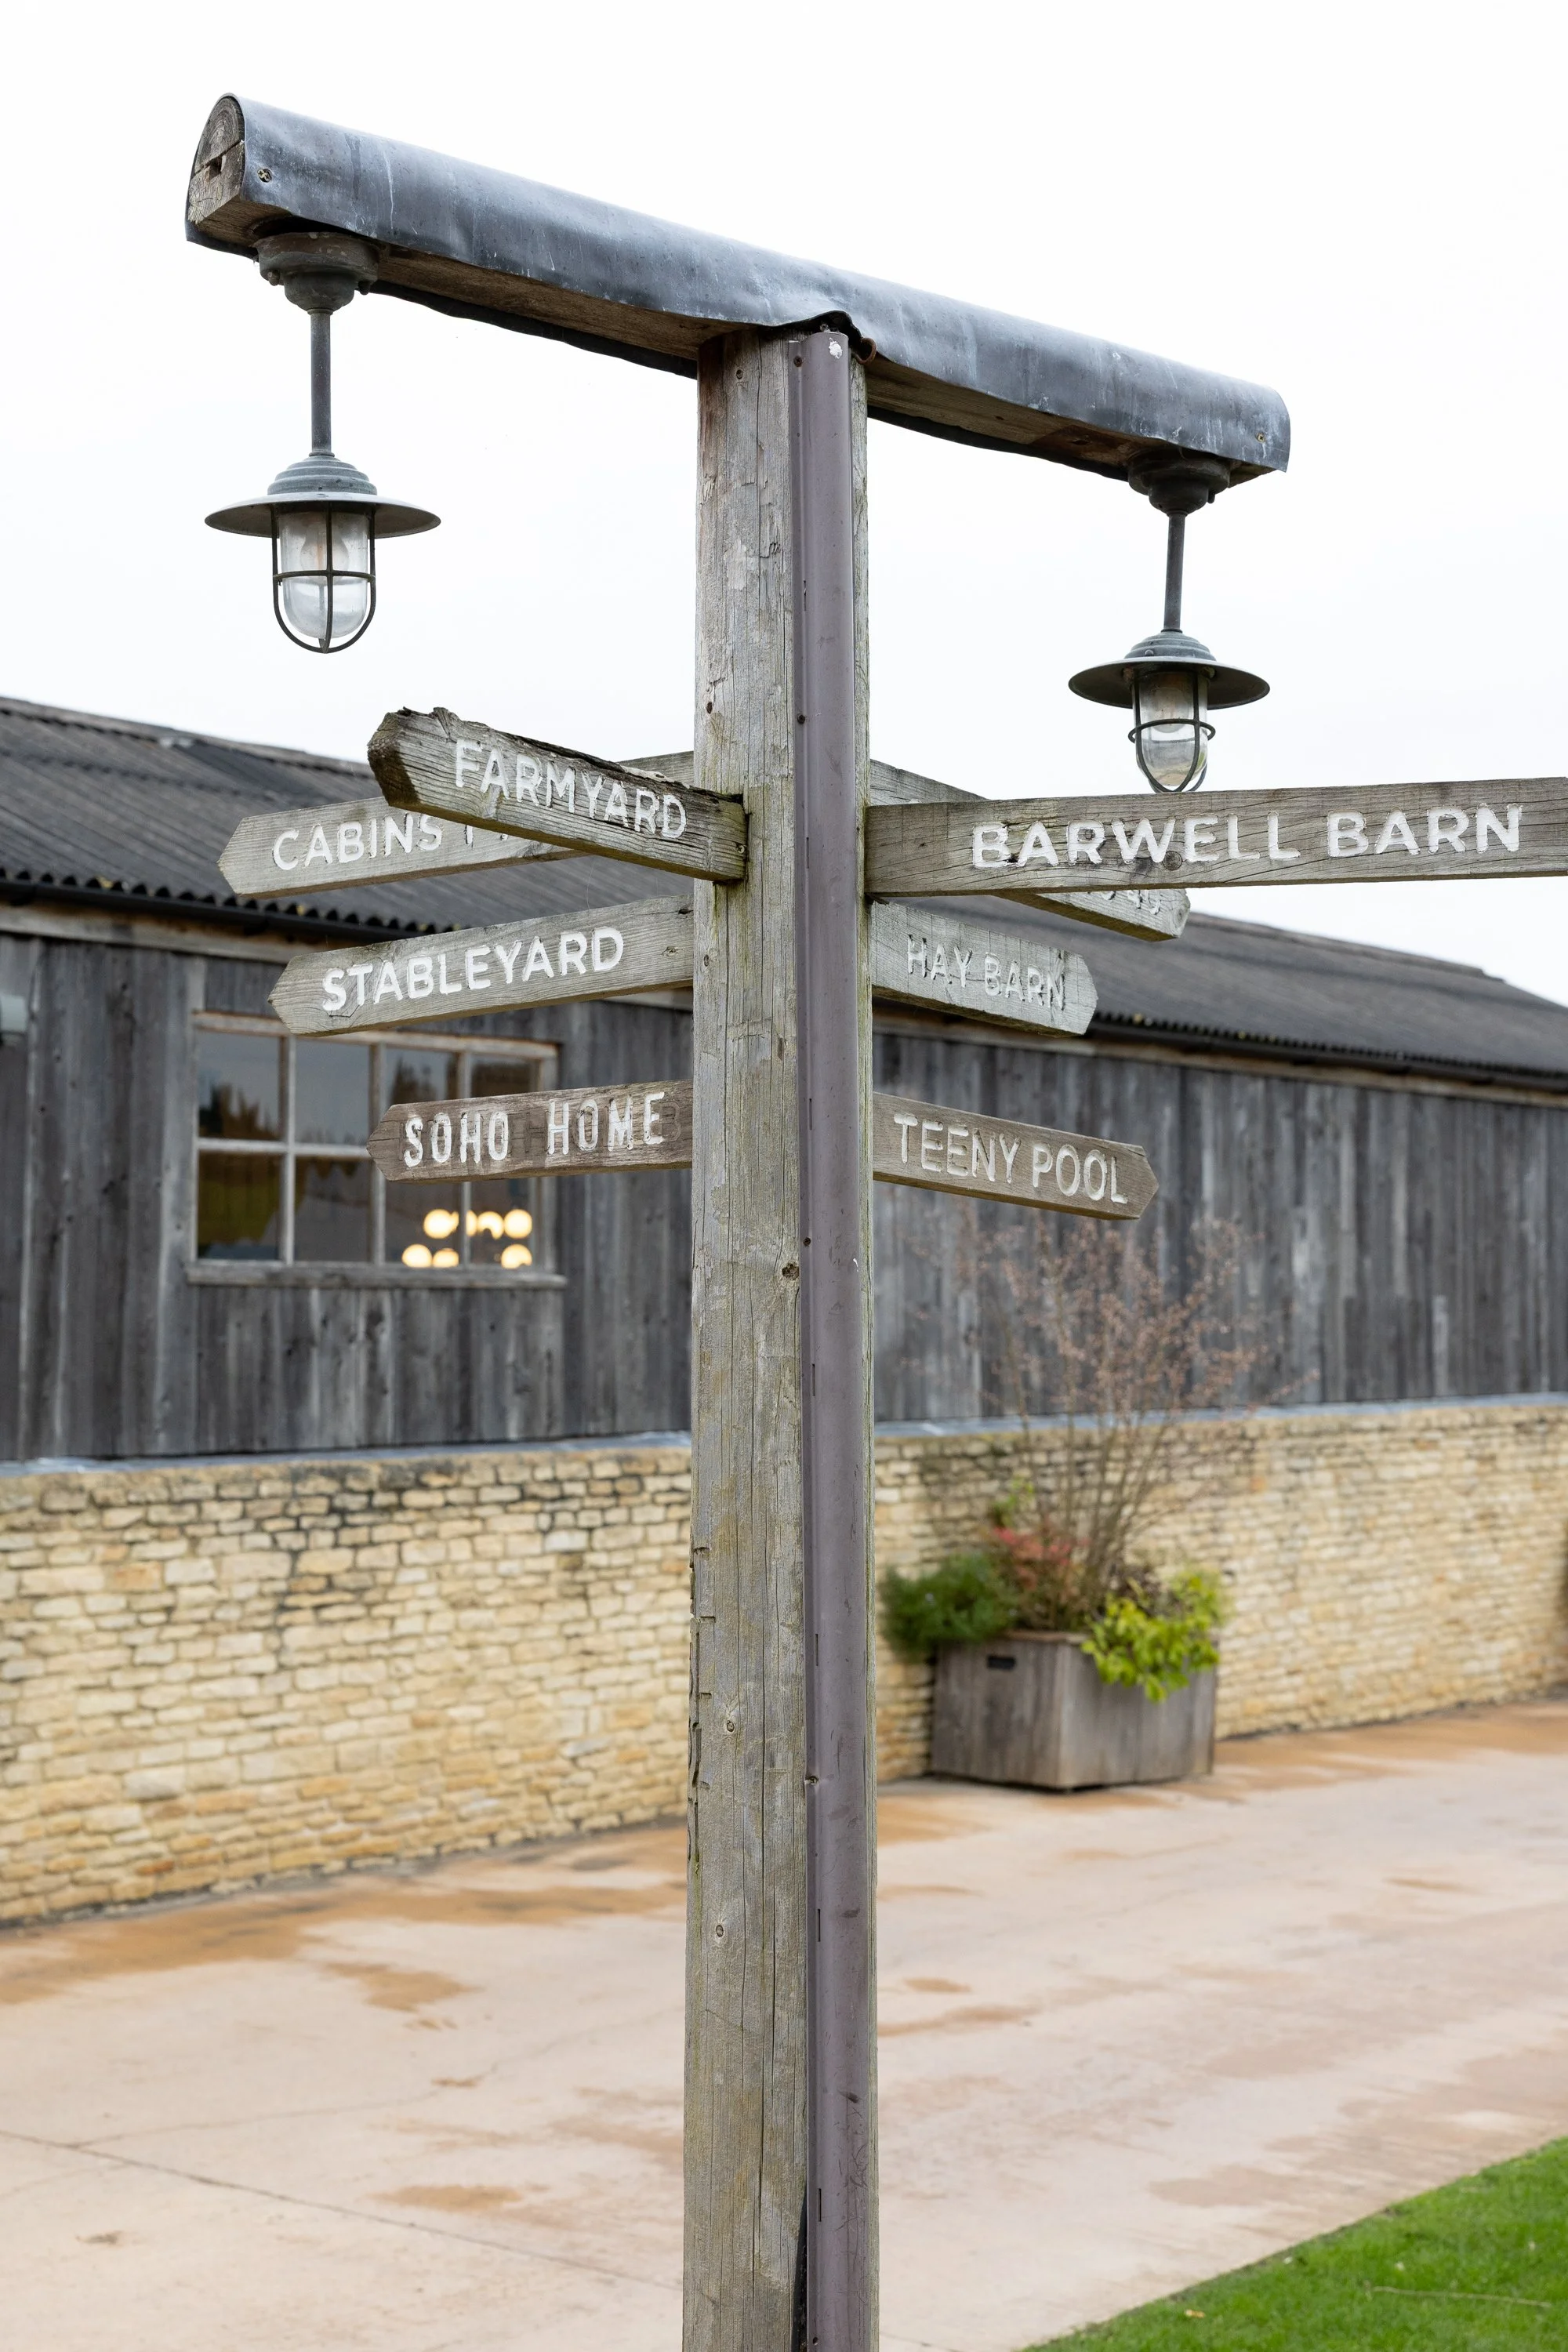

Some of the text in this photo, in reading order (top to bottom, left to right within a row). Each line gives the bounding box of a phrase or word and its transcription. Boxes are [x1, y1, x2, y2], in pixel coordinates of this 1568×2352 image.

[454, 739, 688, 839] FARMYARD
[272, 811, 443, 870] CABINS
[971, 803, 1522, 869] BARWELL BARN
[322, 927, 624, 1011] STABLEYARD
[906, 935, 1065, 1011] HAY BARN
[403, 1091, 665, 1167] SOHO HOME
[894, 1113, 1128, 1204] TEENY POOL
